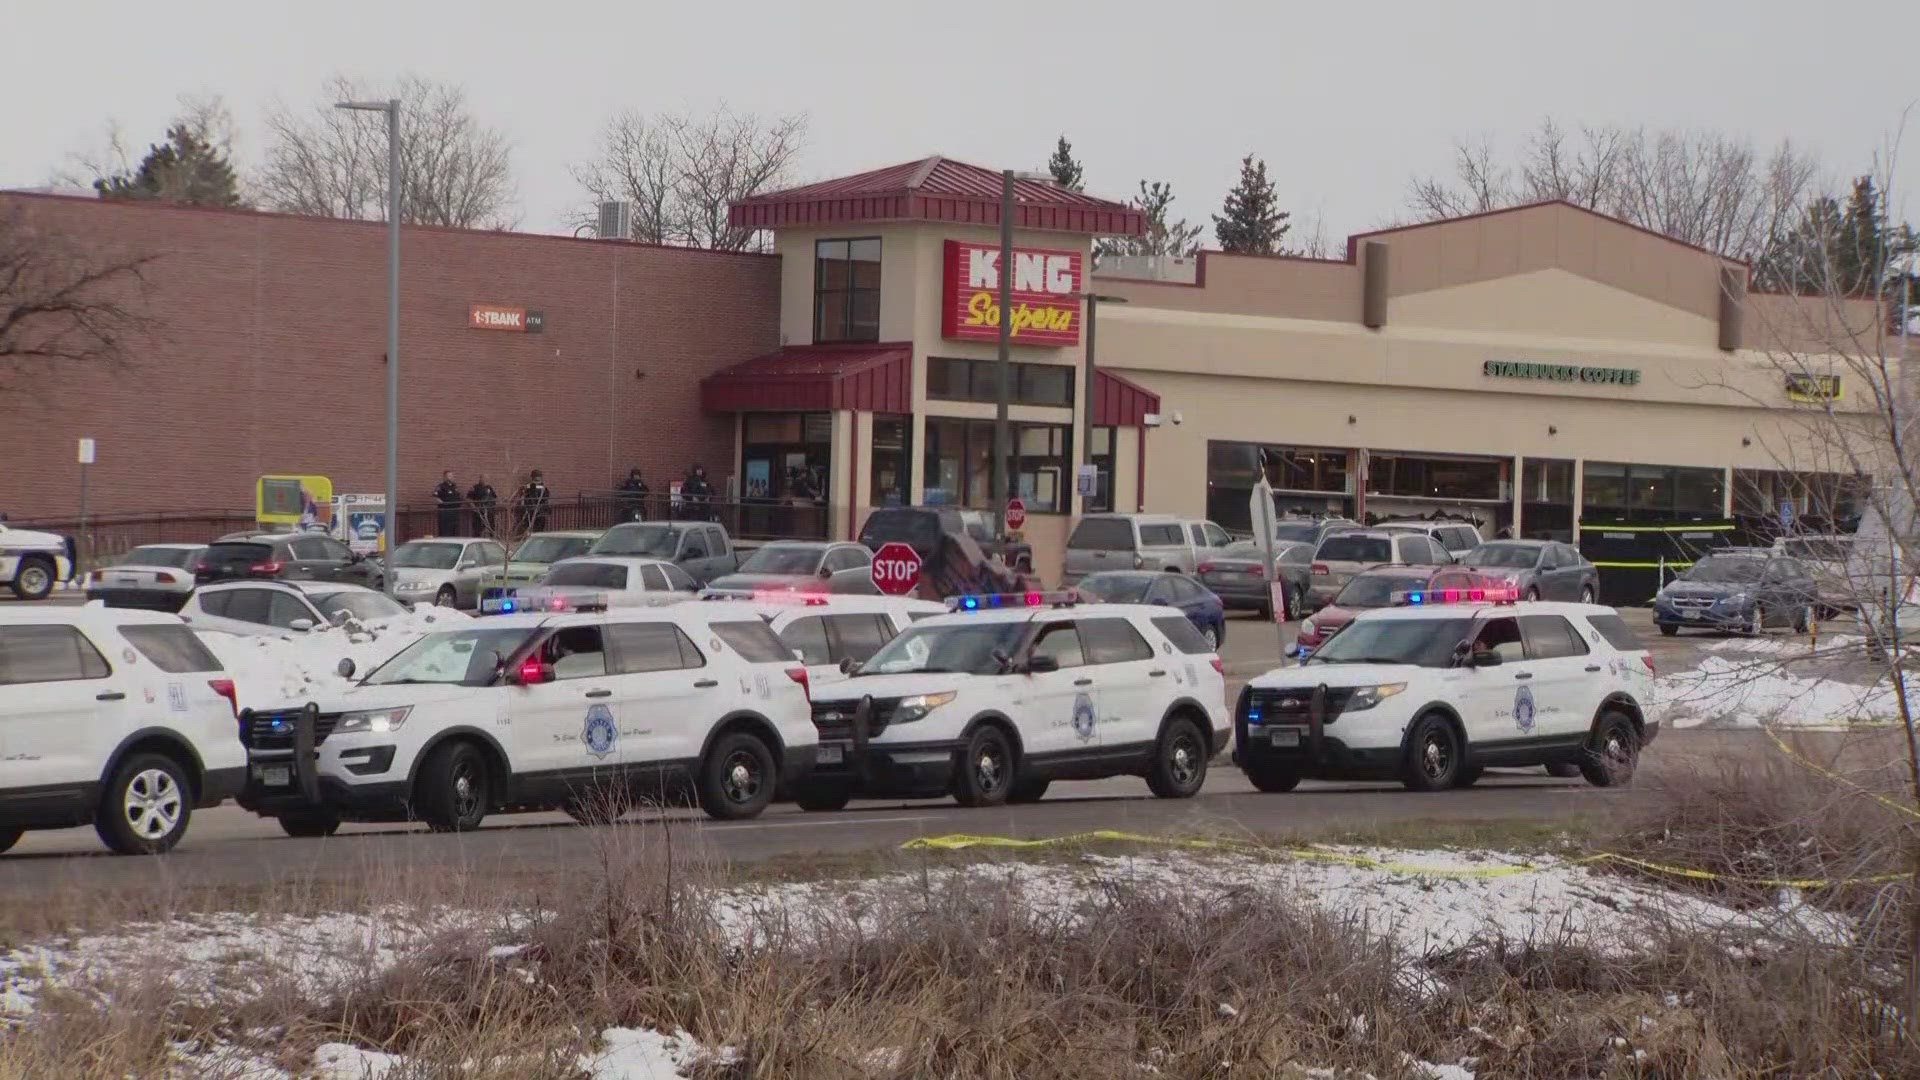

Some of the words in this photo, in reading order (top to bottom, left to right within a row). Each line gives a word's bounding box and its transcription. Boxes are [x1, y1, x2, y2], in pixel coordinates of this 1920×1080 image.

[969, 248, 1073, 294] KNG
[526, 317, 541, 325] ATM
[964, 291, 1073, 337] Sopers
[1484, 360, 1581, 381] STARBUCKS
[1580, 367, 1642, 385] COFFEE
[1007, 509, 1025, 521] STOP
[874, 560, 919, 581] STOP
